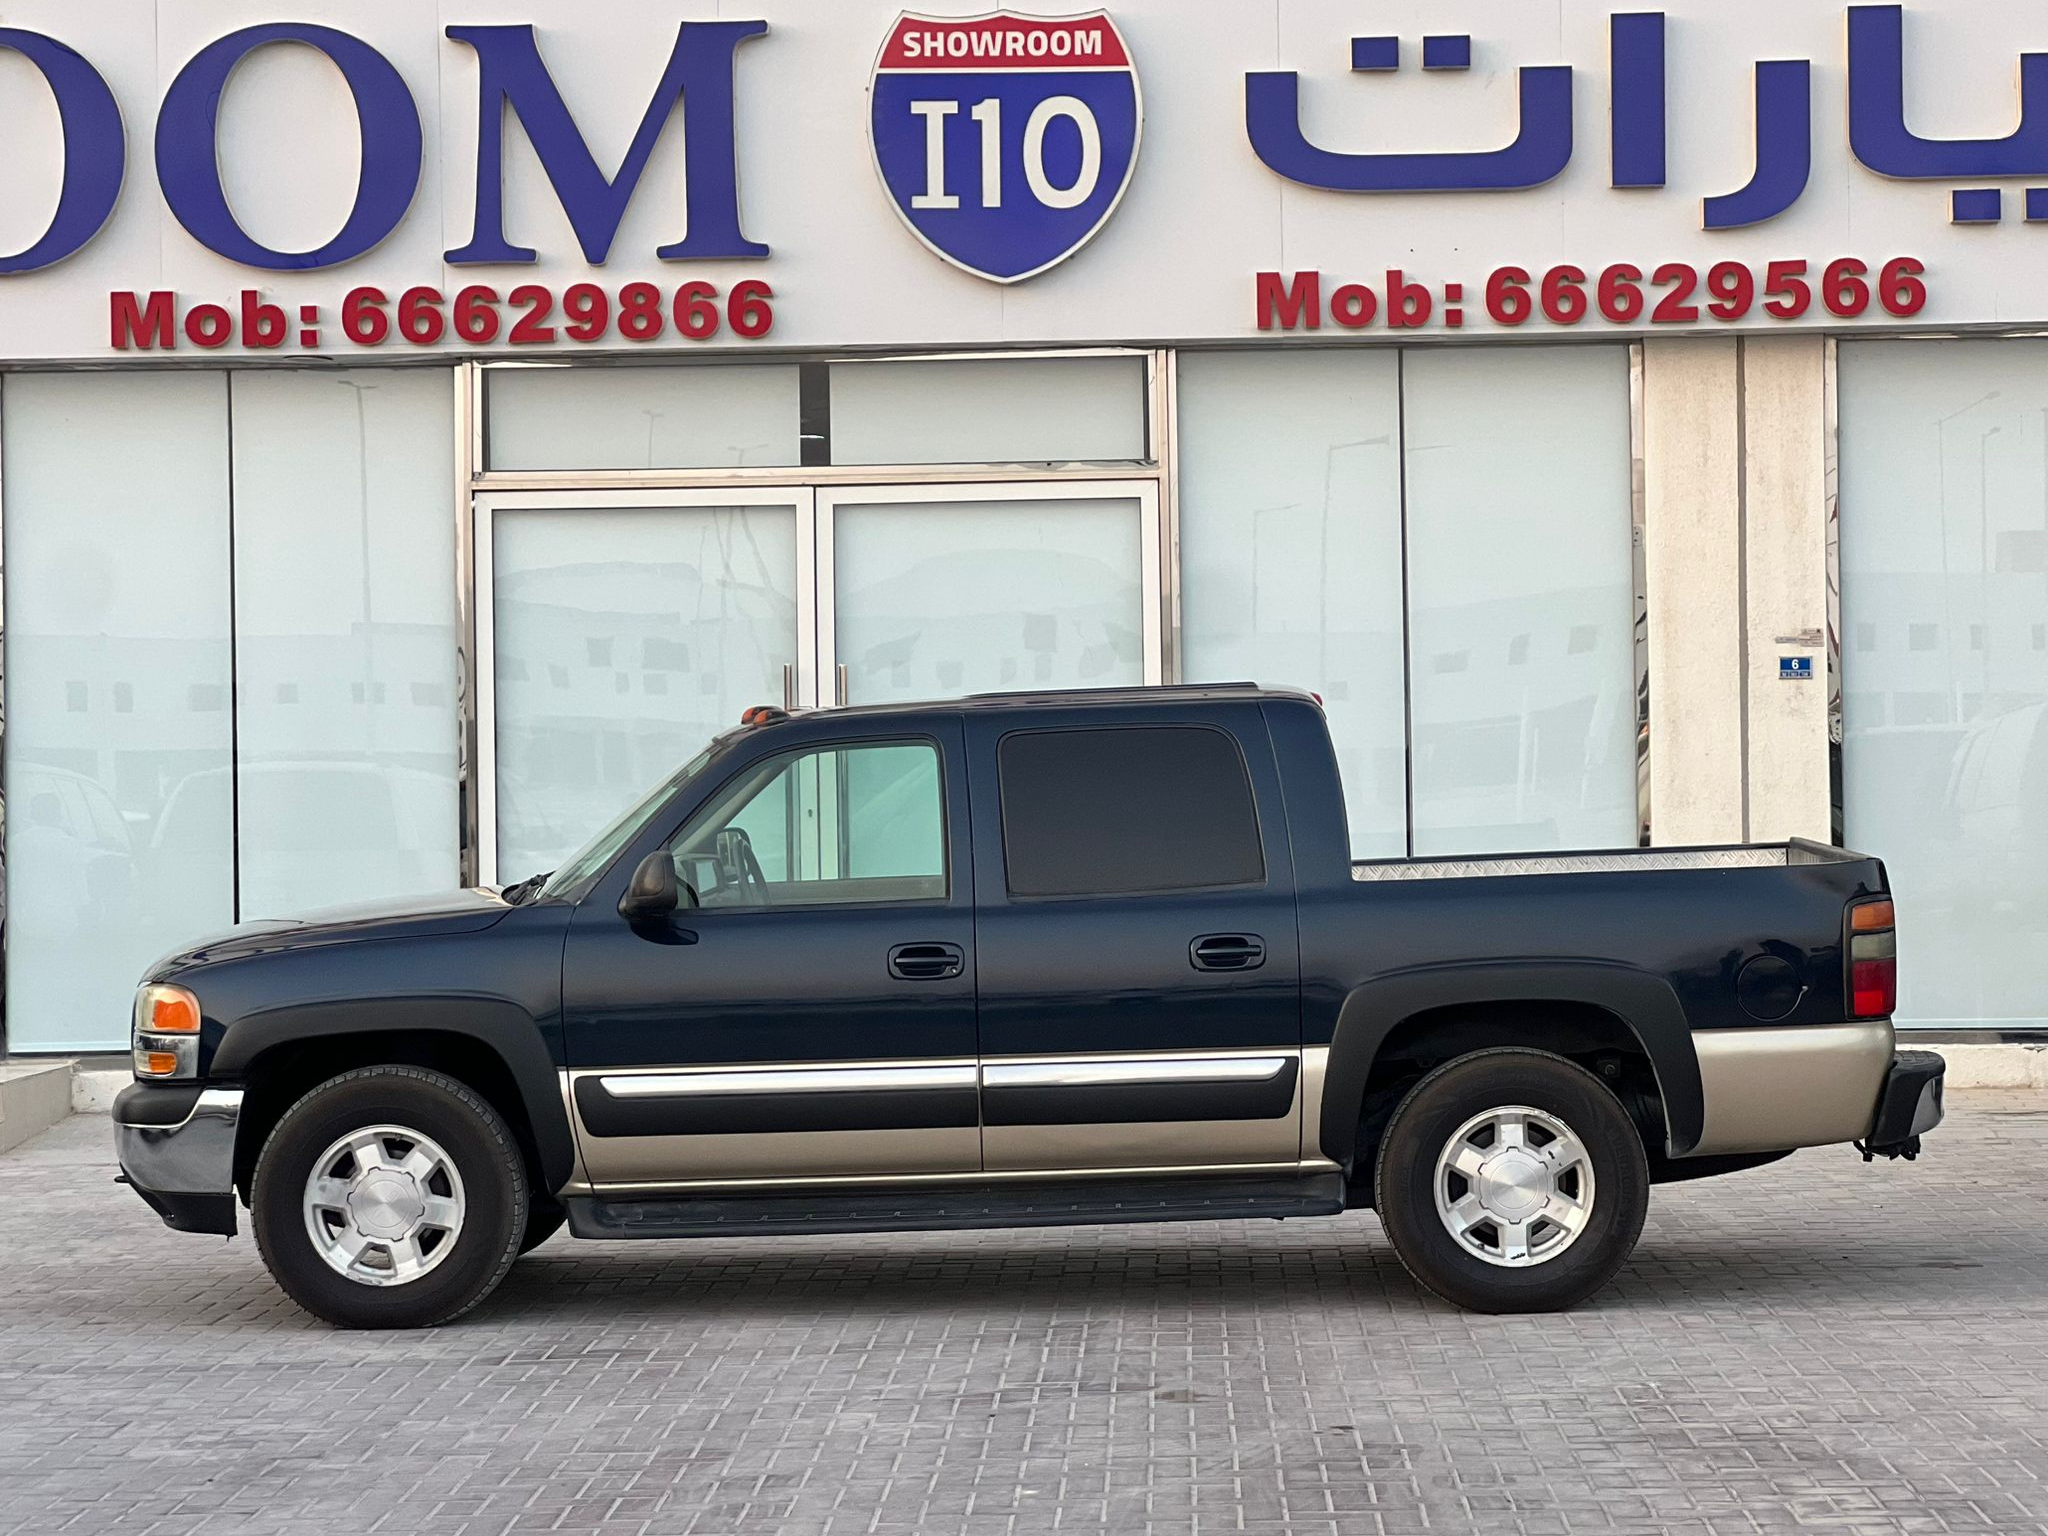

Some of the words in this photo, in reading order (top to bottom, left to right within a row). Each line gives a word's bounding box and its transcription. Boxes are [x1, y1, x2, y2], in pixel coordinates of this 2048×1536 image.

[902, 29, 1103, 58] SHOWROOM
[909, 95, 1102, 209] I10
[341, 279, 774, 346] 66629866
[1485, 257, 1928, 326] 66629566
[1791, 659, 1799, 670] 6
